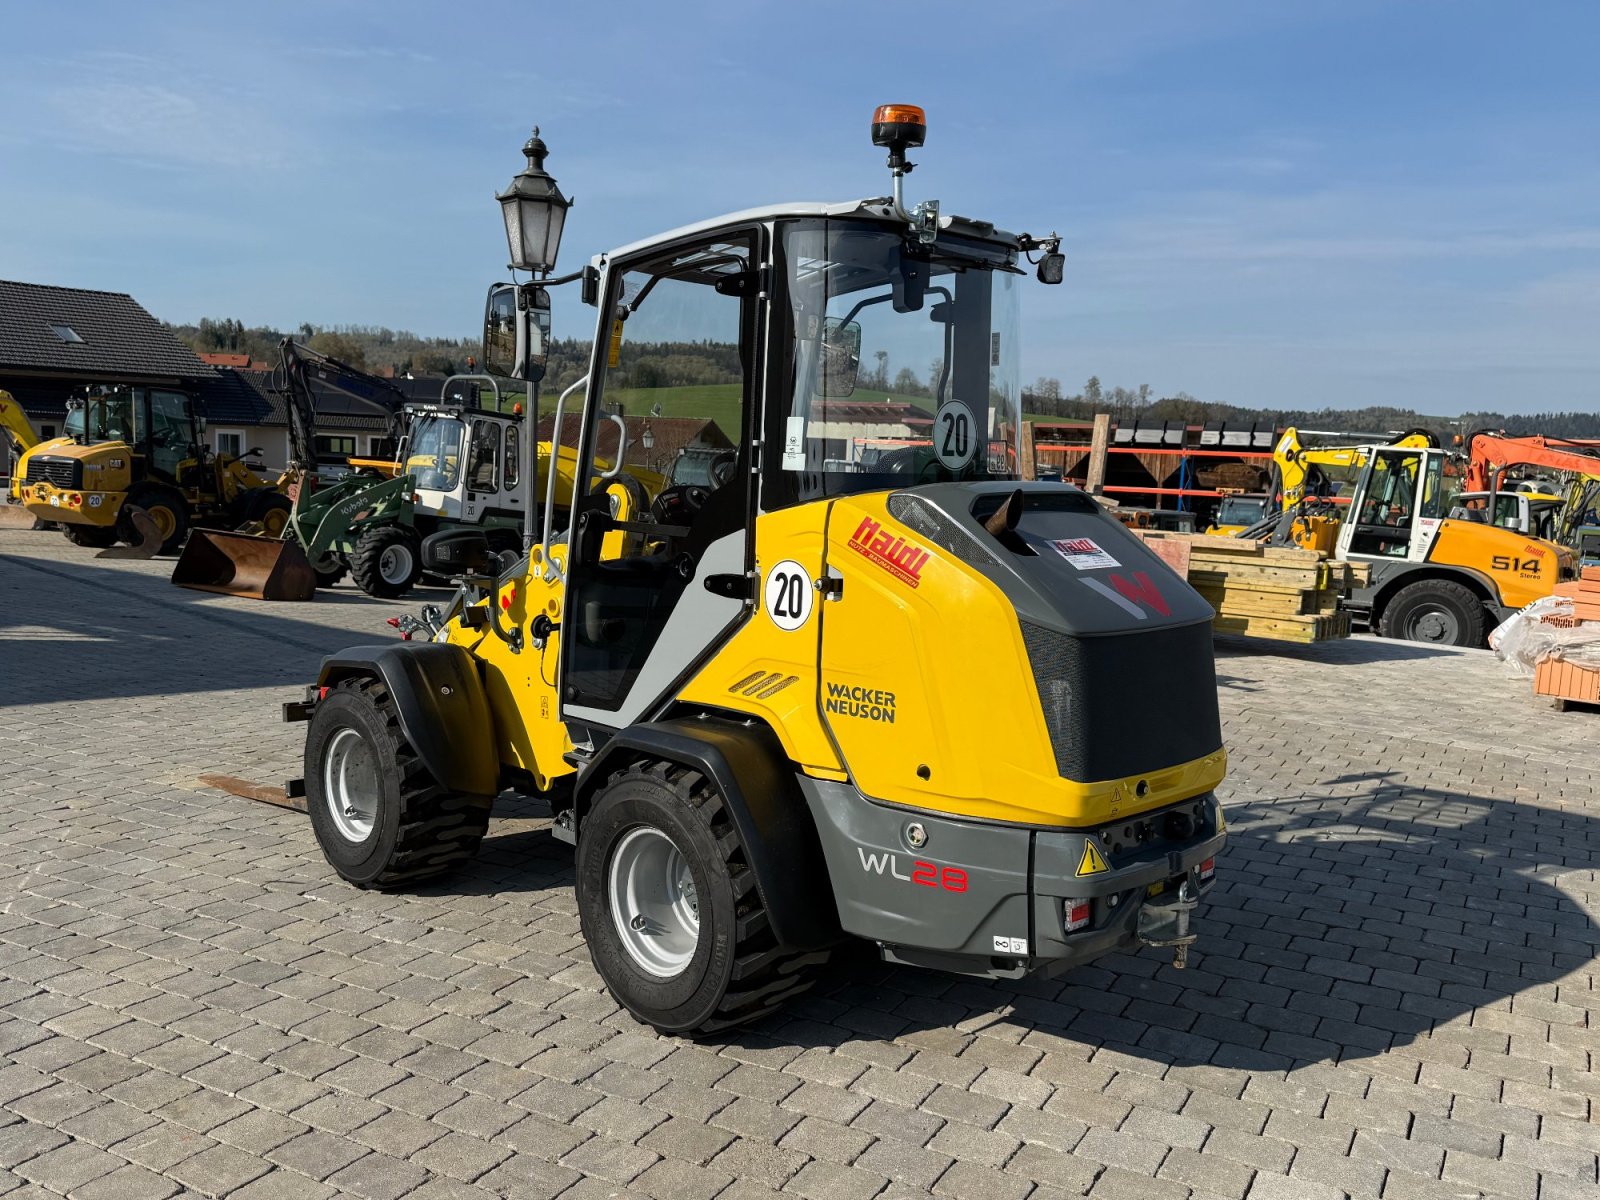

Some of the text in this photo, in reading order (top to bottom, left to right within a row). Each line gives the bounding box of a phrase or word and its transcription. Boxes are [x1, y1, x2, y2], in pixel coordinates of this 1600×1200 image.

[941, 412, 968, 458] 20
[90, 497, 99, 505] 20
[340, 497, 369, 515] Kubota
[467, 505, 475, 516] 20
[868, 553, 918, 587] BAUMASCHINEN
[1491, 555, 1542, 574] 514
[774, 571, 803, 619] 20
[826, 682, 896, 708] WACKER
[826, 697, 895, 724] NEUSON
[857, 846, 969, 893] WL28
